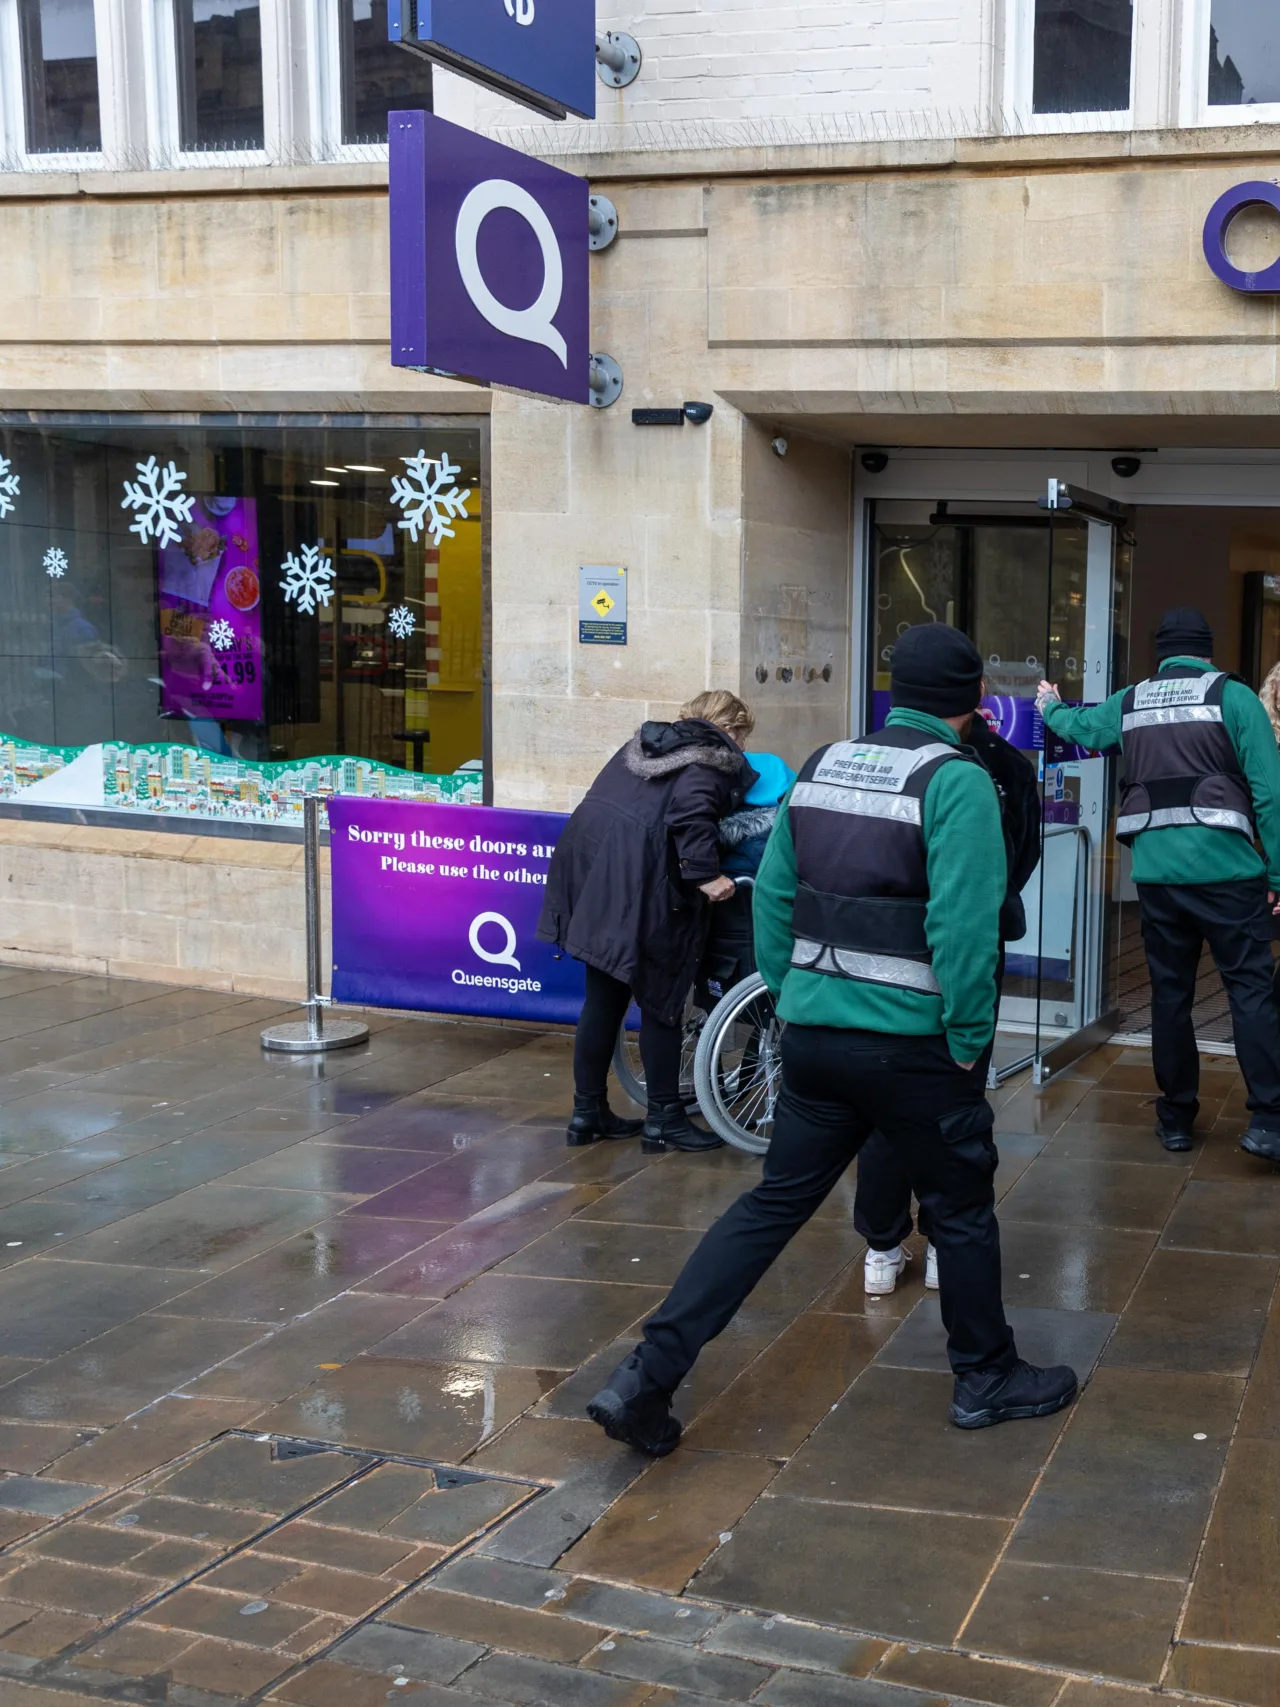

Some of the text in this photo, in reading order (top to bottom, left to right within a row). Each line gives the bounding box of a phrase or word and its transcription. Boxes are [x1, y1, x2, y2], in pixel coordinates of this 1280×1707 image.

[455, 179, 568, 370] Q
[1137, 697, 1176, 706] ENFORCEMENT
[1146, 690, 1180, 698] PREVENTION
[833, 760, 894, 775] PREVENTION AND
[348, 824, 555, 859] Sorry these doors ar
[381, 856, 435, 875] Please
[439, 864, 468, 878] use
[472, 864, 500, 881] the
[468, 911, 521, 972] Q
[451, 969, 542, 994] Queensgate
